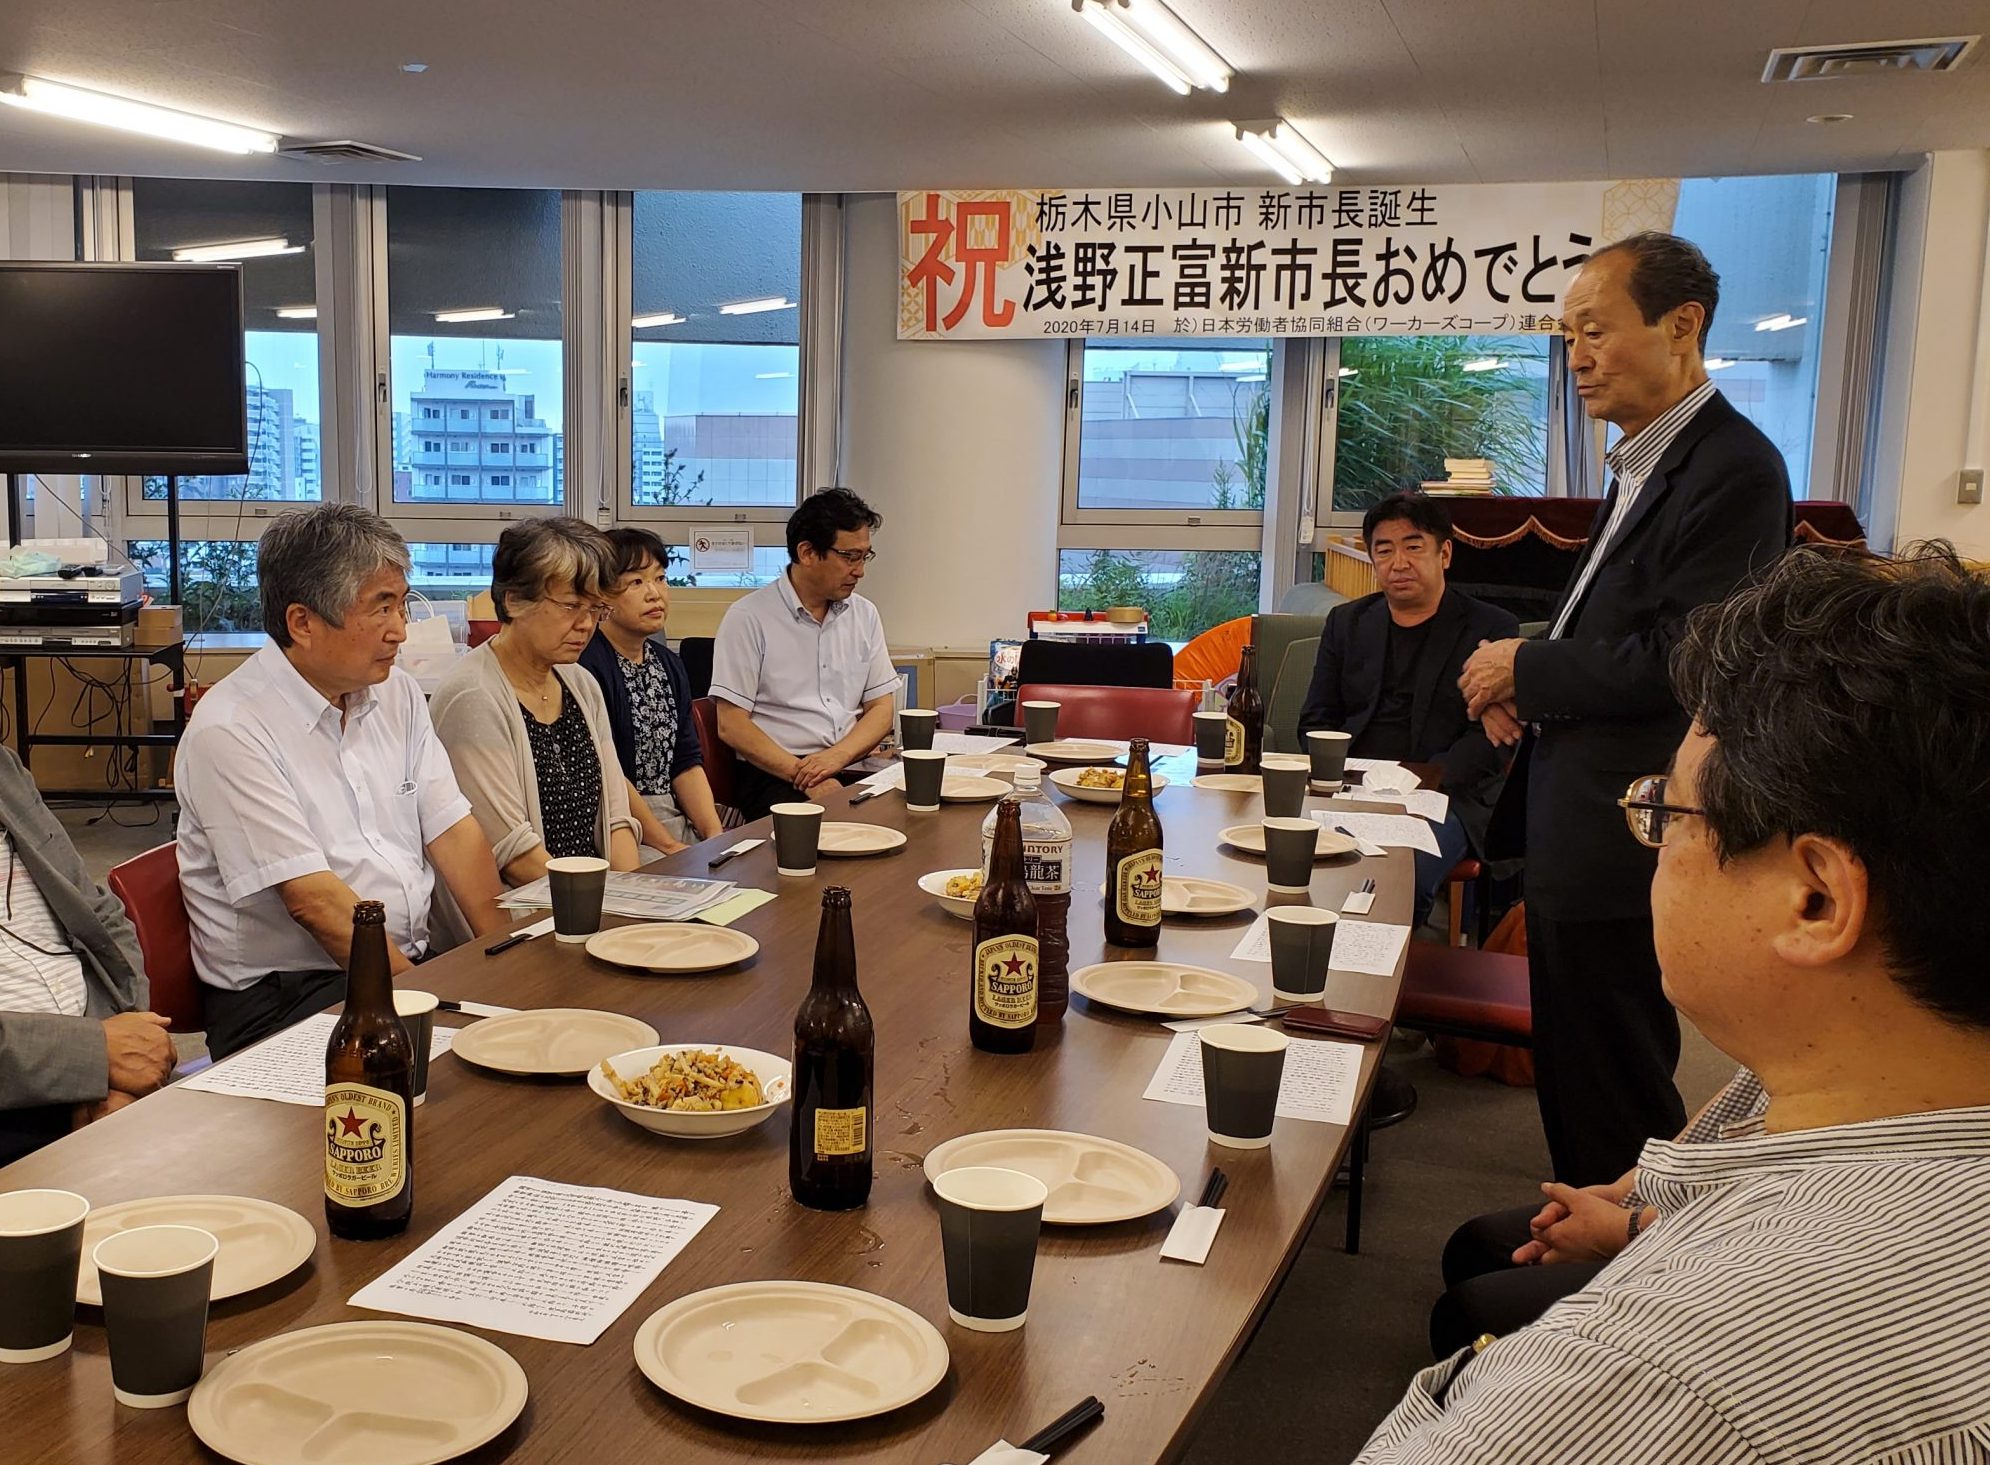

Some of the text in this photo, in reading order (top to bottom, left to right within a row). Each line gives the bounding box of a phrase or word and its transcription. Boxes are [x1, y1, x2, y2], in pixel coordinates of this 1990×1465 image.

[1035, 188, 1438, 233] 栃木県小山市 新市長誕生
[907, 193, 1016, 332] 祝
[1043, 318, 1155, 334] 2020年7月14日
[426, 371, 498, 380] Harmony Residence
[1023, 845, 1063, 854] NTORY
[992, 981, 1032, 994] SAPPORO
[340, 1092, 367, 1103] OLDEST
[368, 1097, 392, 1112] BRAND
[330, 1143, 381, 1162] SAPPORO
[345, 1185, 377, 1196] SAPPORO
